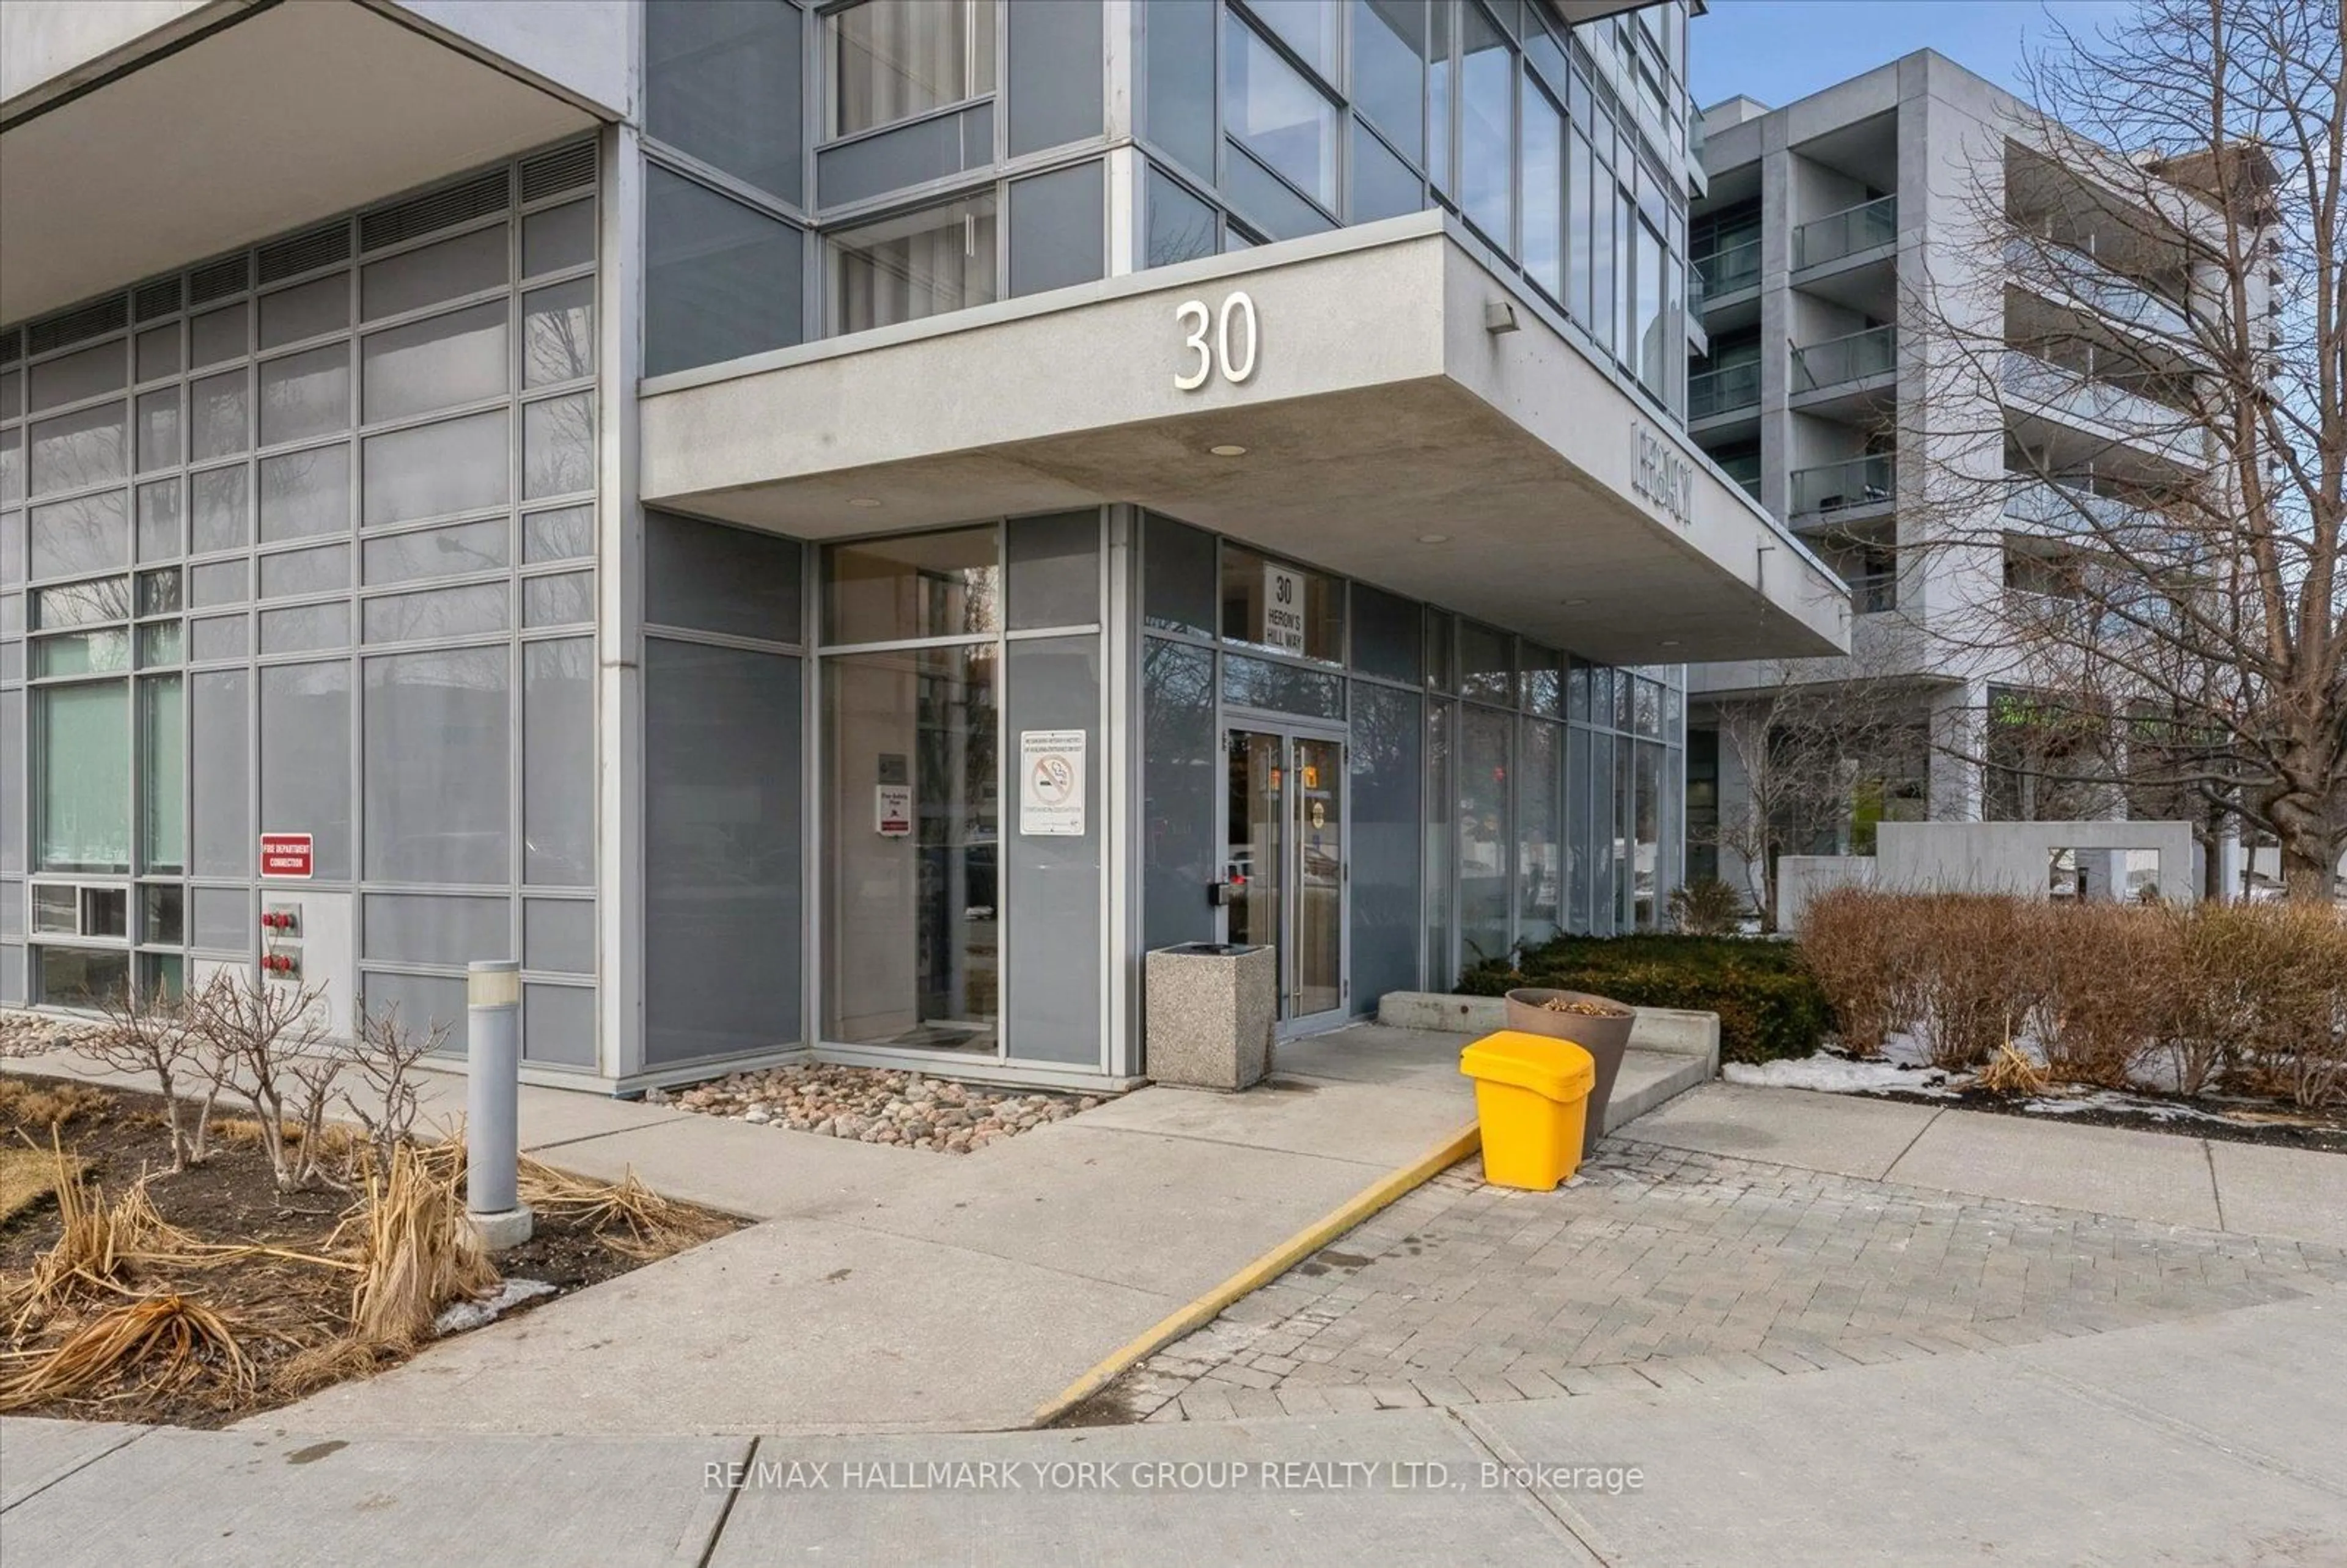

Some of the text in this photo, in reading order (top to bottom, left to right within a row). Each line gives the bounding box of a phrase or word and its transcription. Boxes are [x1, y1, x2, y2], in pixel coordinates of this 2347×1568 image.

[1174, 291, 1257, 390] 30
[1276, 576, 1292, 604] 30
[1285, 631, 1302, 649] WAY
